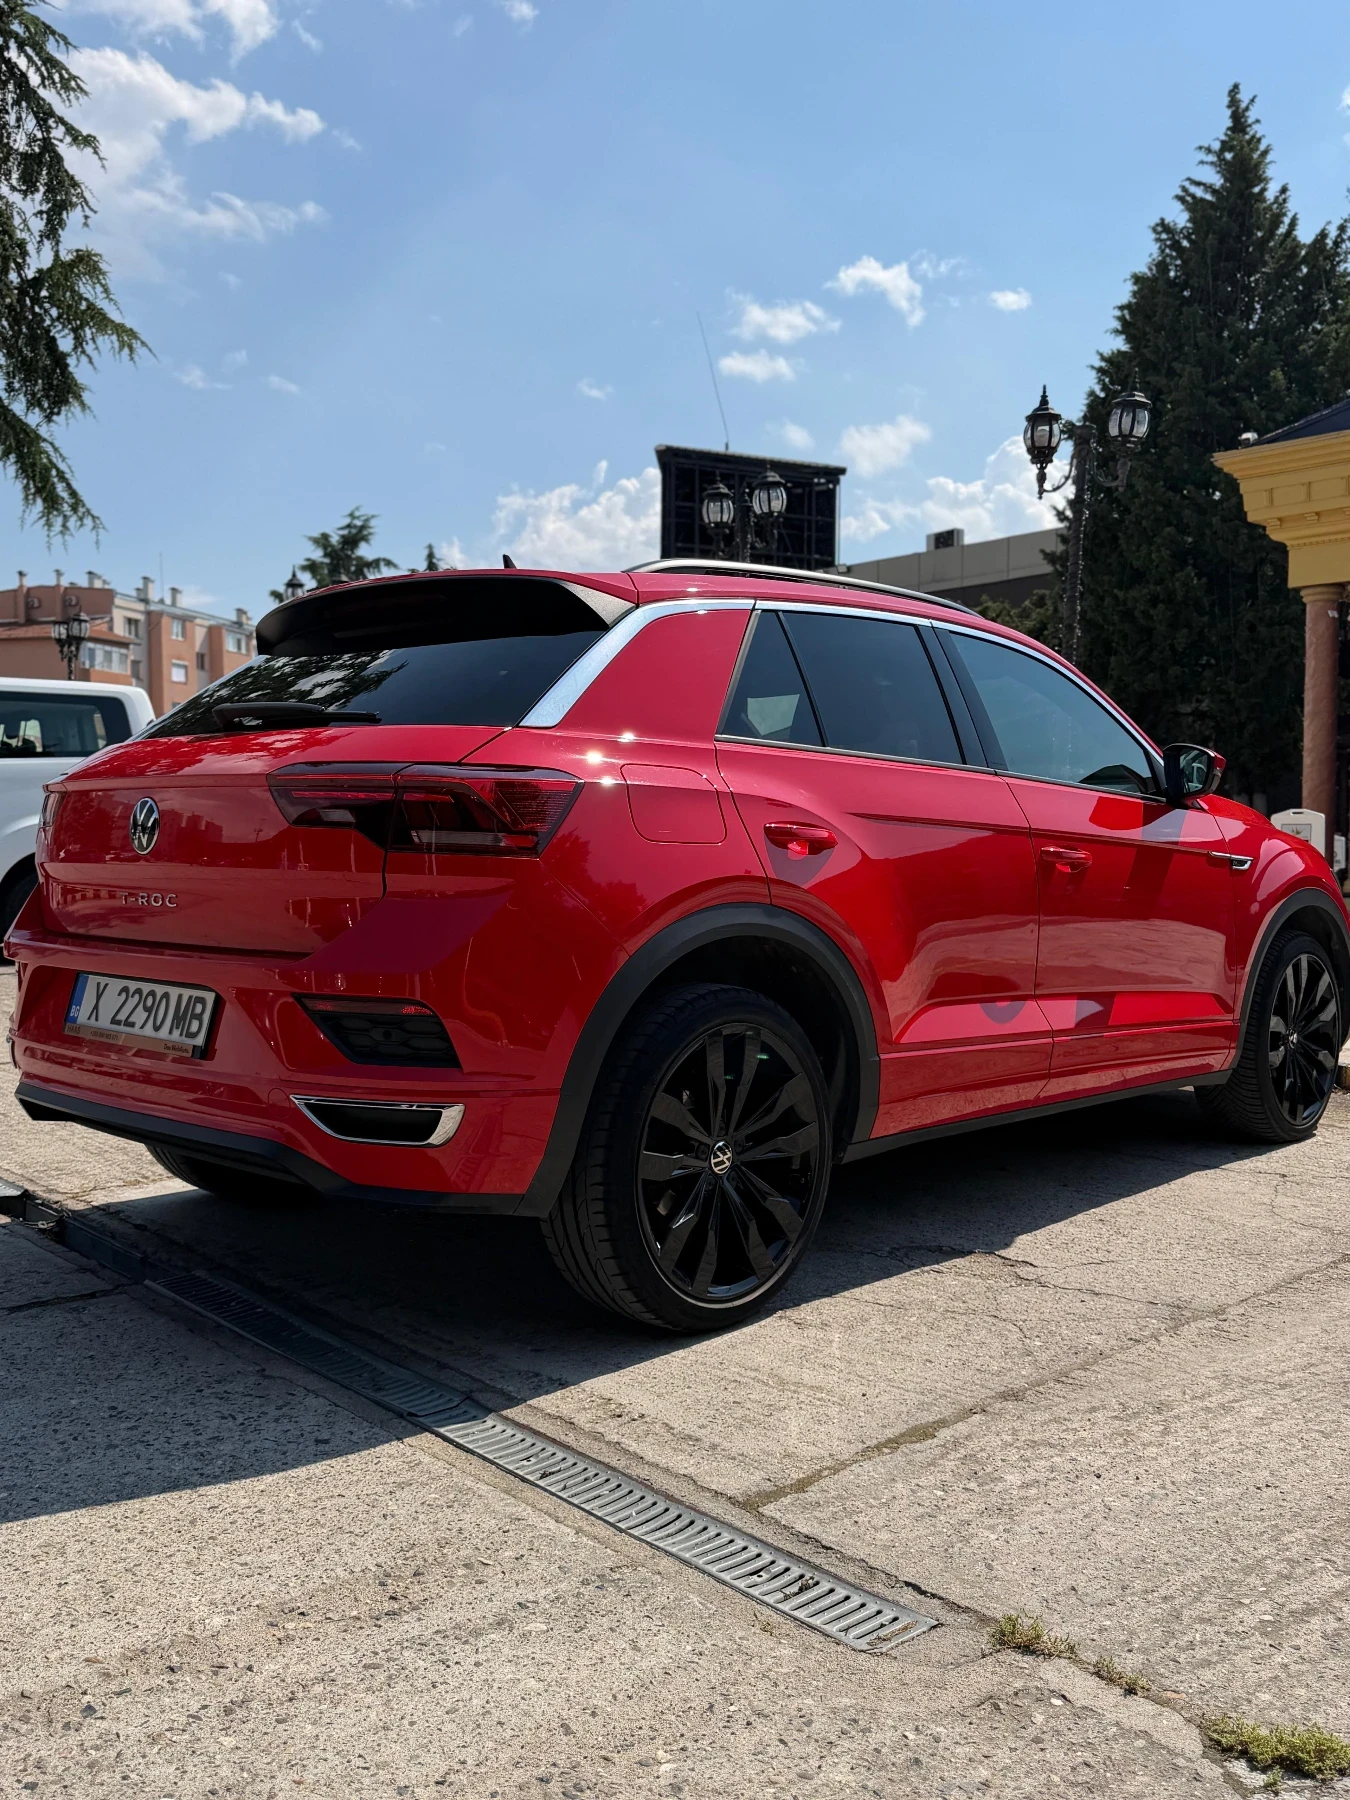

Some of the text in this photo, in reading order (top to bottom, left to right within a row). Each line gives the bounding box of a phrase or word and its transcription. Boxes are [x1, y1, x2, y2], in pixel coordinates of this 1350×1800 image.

[120, 892, 178, 907] T-ROC
[70, 1005, 80, 1018] BG
[87, 981, 207, 1039] X 2290 MB
